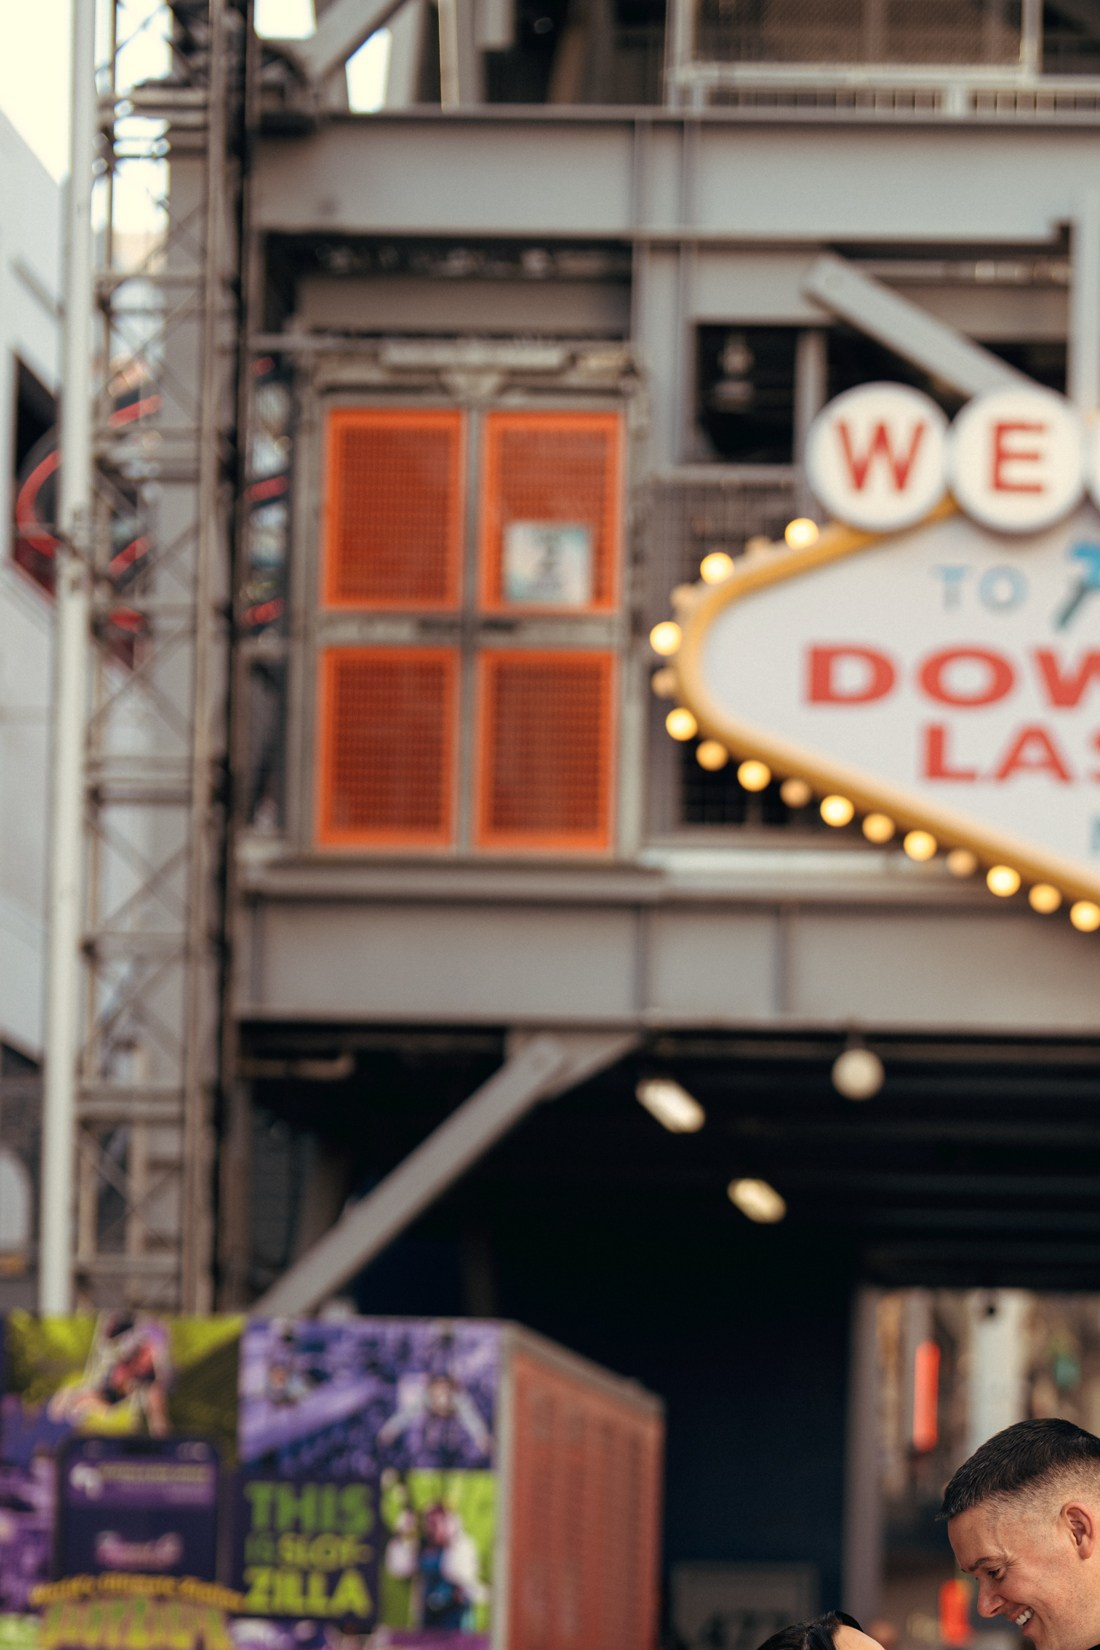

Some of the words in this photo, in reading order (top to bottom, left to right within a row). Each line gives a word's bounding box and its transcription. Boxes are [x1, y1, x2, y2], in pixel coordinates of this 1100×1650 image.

[931, 563, 1030, 616] TO
[244, 1481, 374, 1535] THIS
[243, 1566, 374, 1618] ZILLA
